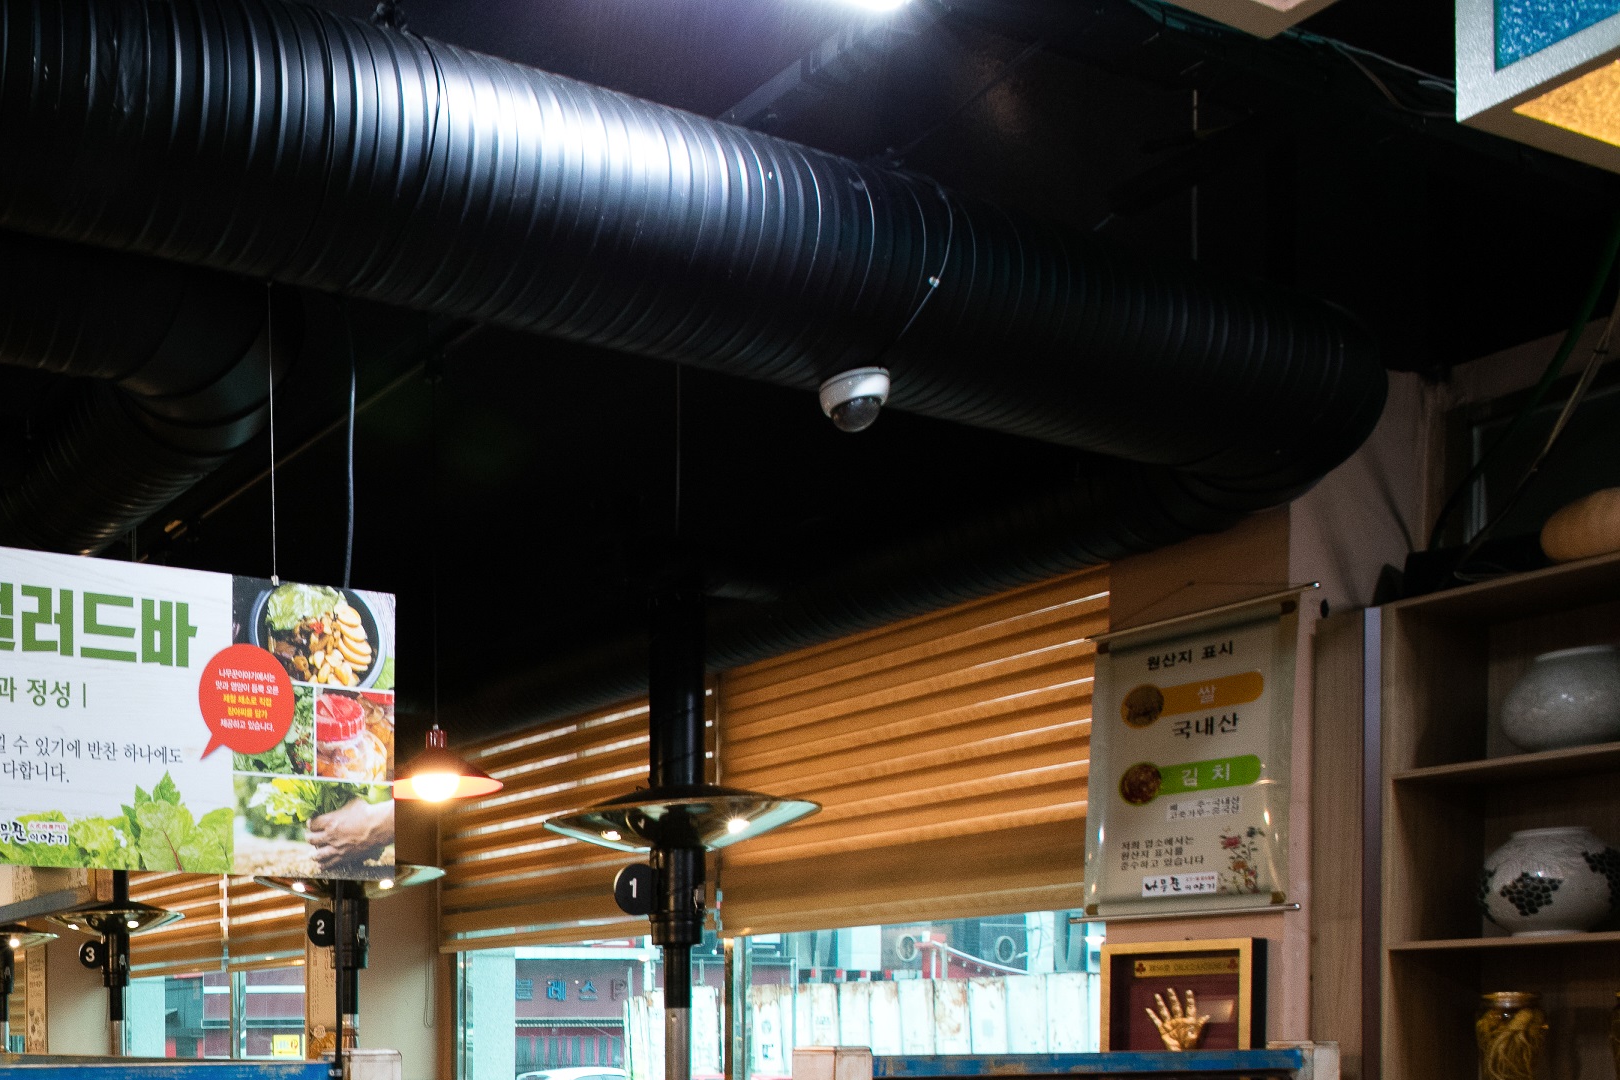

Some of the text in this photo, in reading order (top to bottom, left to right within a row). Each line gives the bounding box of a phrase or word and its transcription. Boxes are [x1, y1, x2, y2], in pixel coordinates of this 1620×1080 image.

[1147, 640, 1233, 671] 원산지 표시
[26, 678, 72, 709] 정성
[1197, 685, 1217, 704] 쌀
[1172, 712, 1239, 739] 국내산
[13, 735, 29, 756] 수
[35, 737, 81, 759] 있기에
[87, 741, 118, 762] 반찬
[124, 744, 183, 765] 하나에도
[3, 761, 70, 784] 다합니다.
[629, 877, 637, 899] 1
[316, 919, 325, 934] 2
[85, 947, 95, 962] 3
